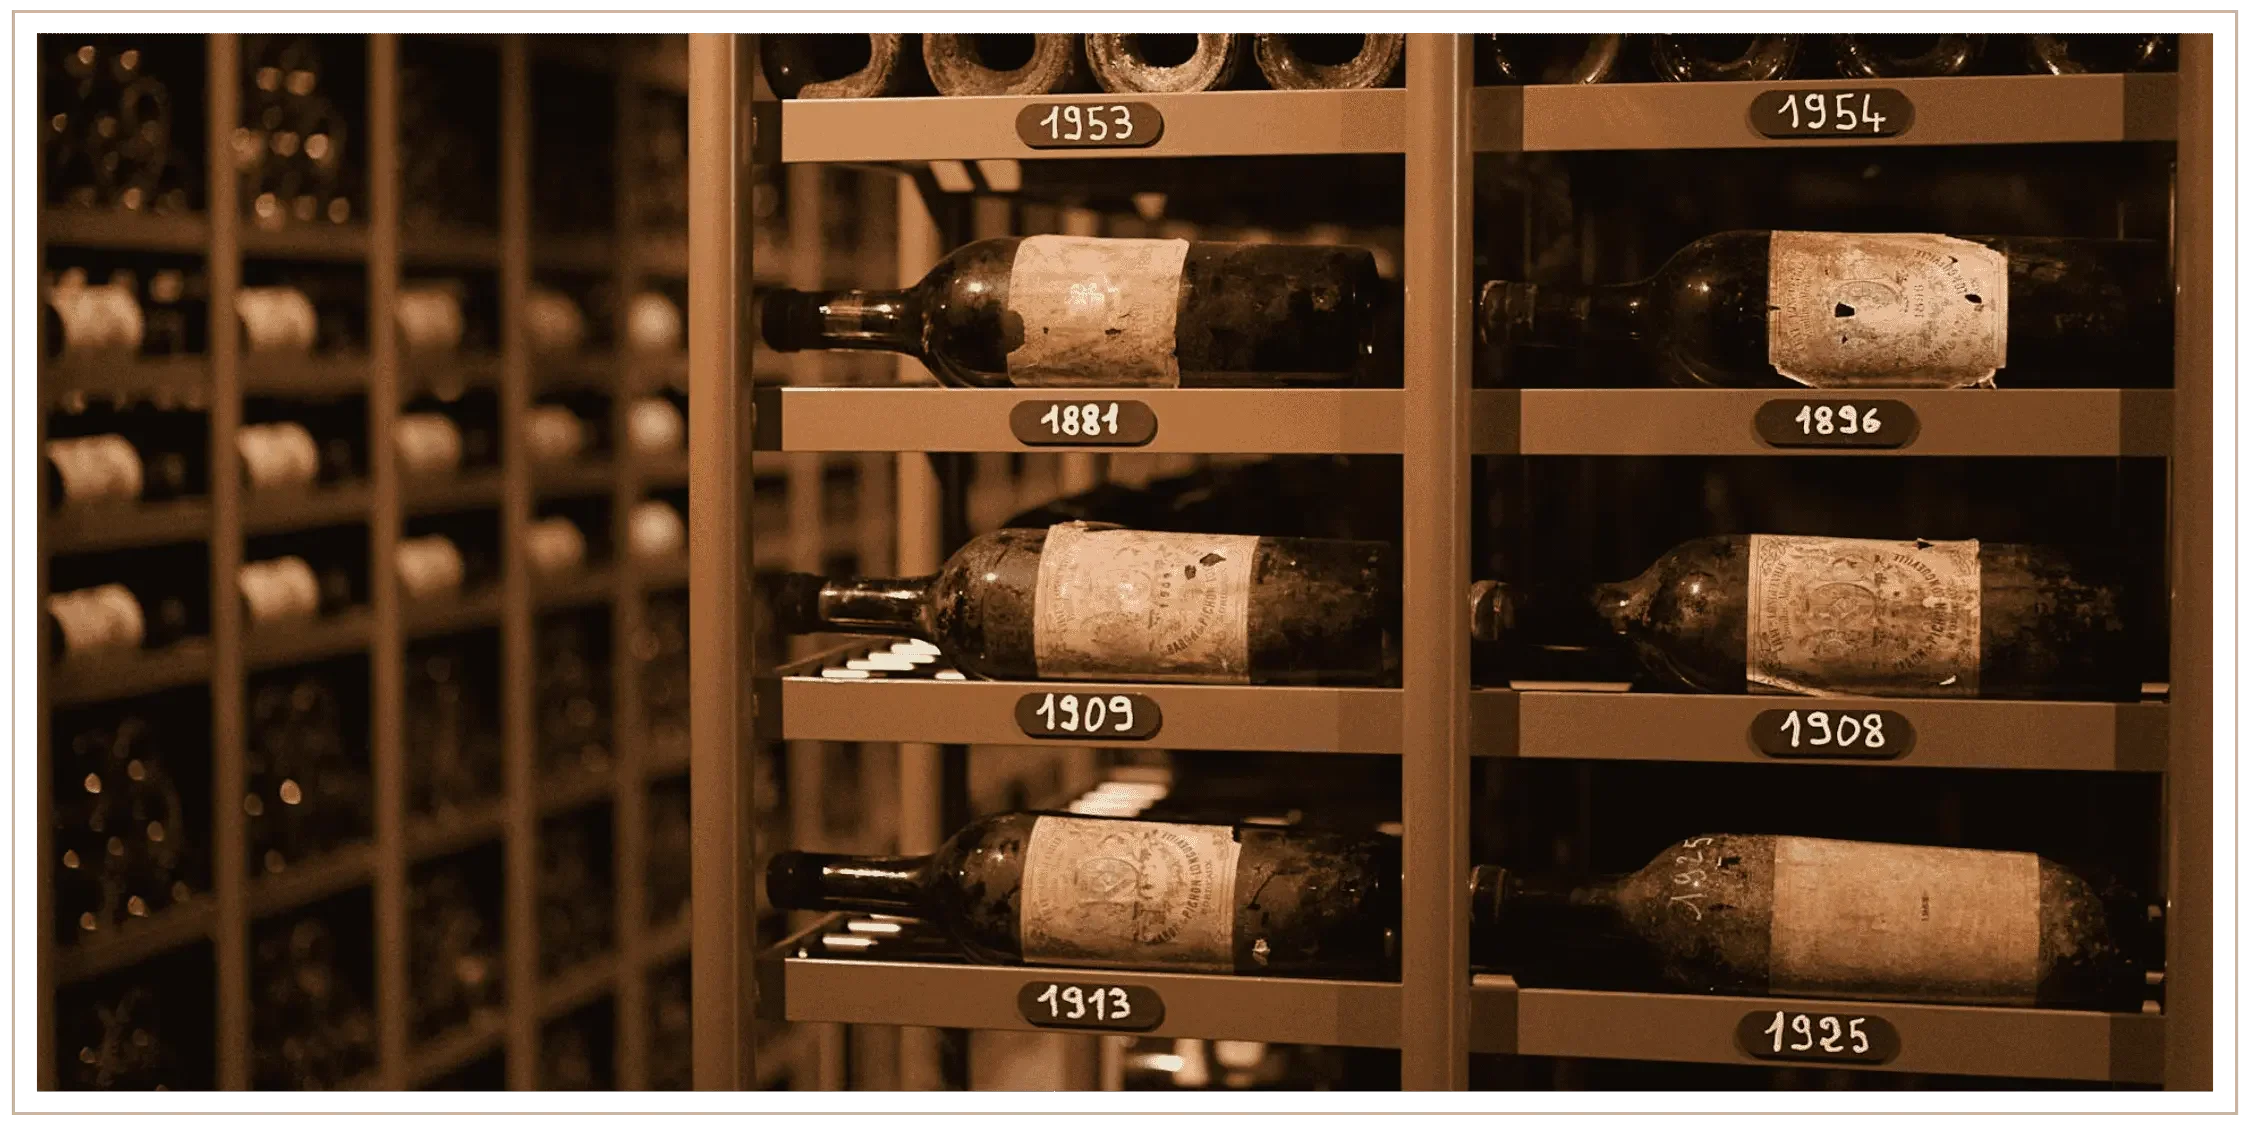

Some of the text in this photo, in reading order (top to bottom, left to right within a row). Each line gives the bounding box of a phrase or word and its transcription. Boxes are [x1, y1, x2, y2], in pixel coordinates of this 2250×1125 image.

[1040, 105, 1133, 141] 1953
[1778, 93, 1886, 133] 1954
[1040, 402, 1119, 436] 1881
[1795, 405, 1881, 435] 1896
[1892, 552, 1945, 598] LONGUEVILLE
[1036, 693, 1134, 732] 1909
[1781, 710, 1885, 748] 1908
[1666, 837, 1714, 921] 1925
[1181, 879, 1202, 920] PICHON
[1037, 984, 1130, 1020] 1913
[1765, 1010, 1869, 1053] 1925
